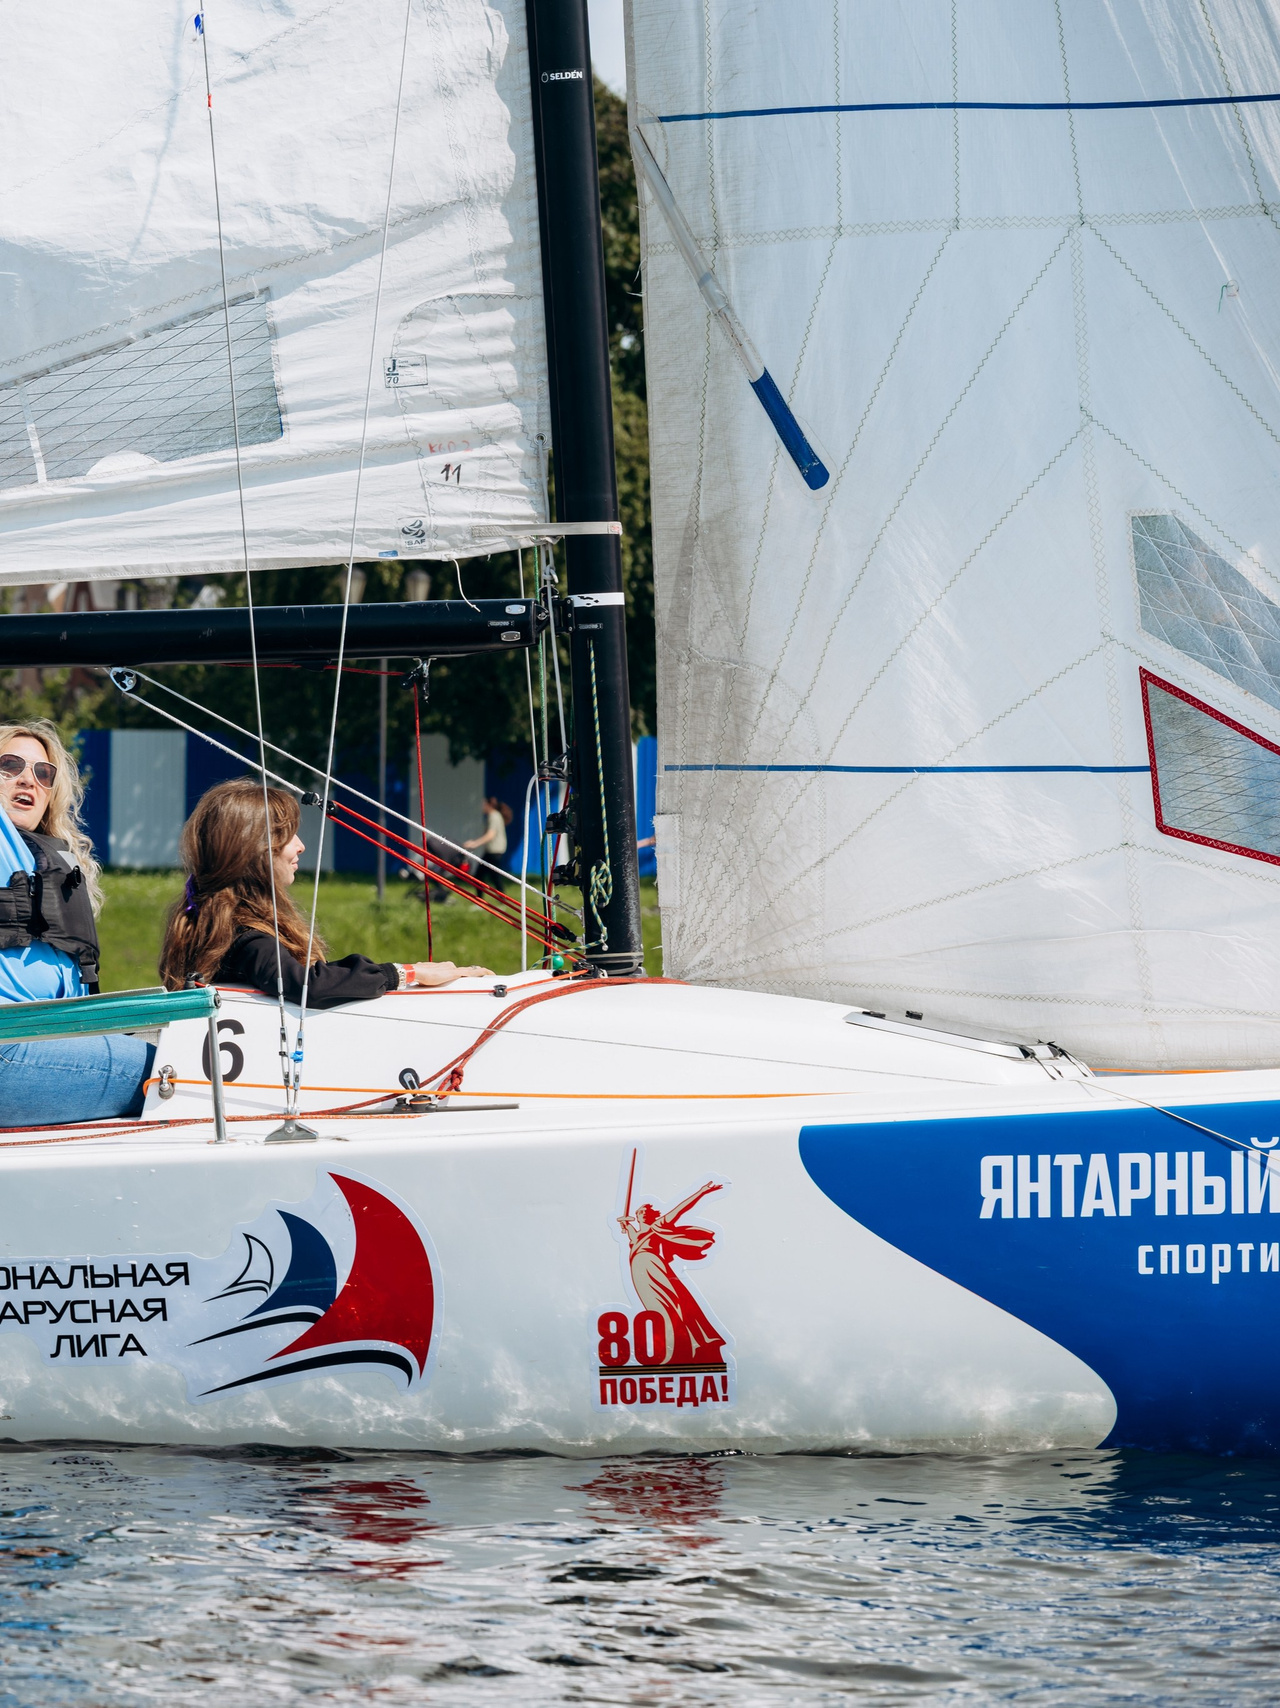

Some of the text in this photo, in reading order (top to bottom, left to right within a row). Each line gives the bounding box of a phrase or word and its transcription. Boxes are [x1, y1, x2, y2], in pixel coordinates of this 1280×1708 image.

[550, 70, 583, 81] SELDÉN
[440, 463, 462, 485] 11
[202, 1018, 246, 1084] 6
[979, 1136, 1280, 1220] ЯНТАРНЫЙ
[1137, 1242, 1280, 1285] спорти
[50, 1332, 148, 1359] ЛИГА
[597, 1310, 667, 1367] 80
[599, 1375, 730, 1407] ПОБЕДА!
